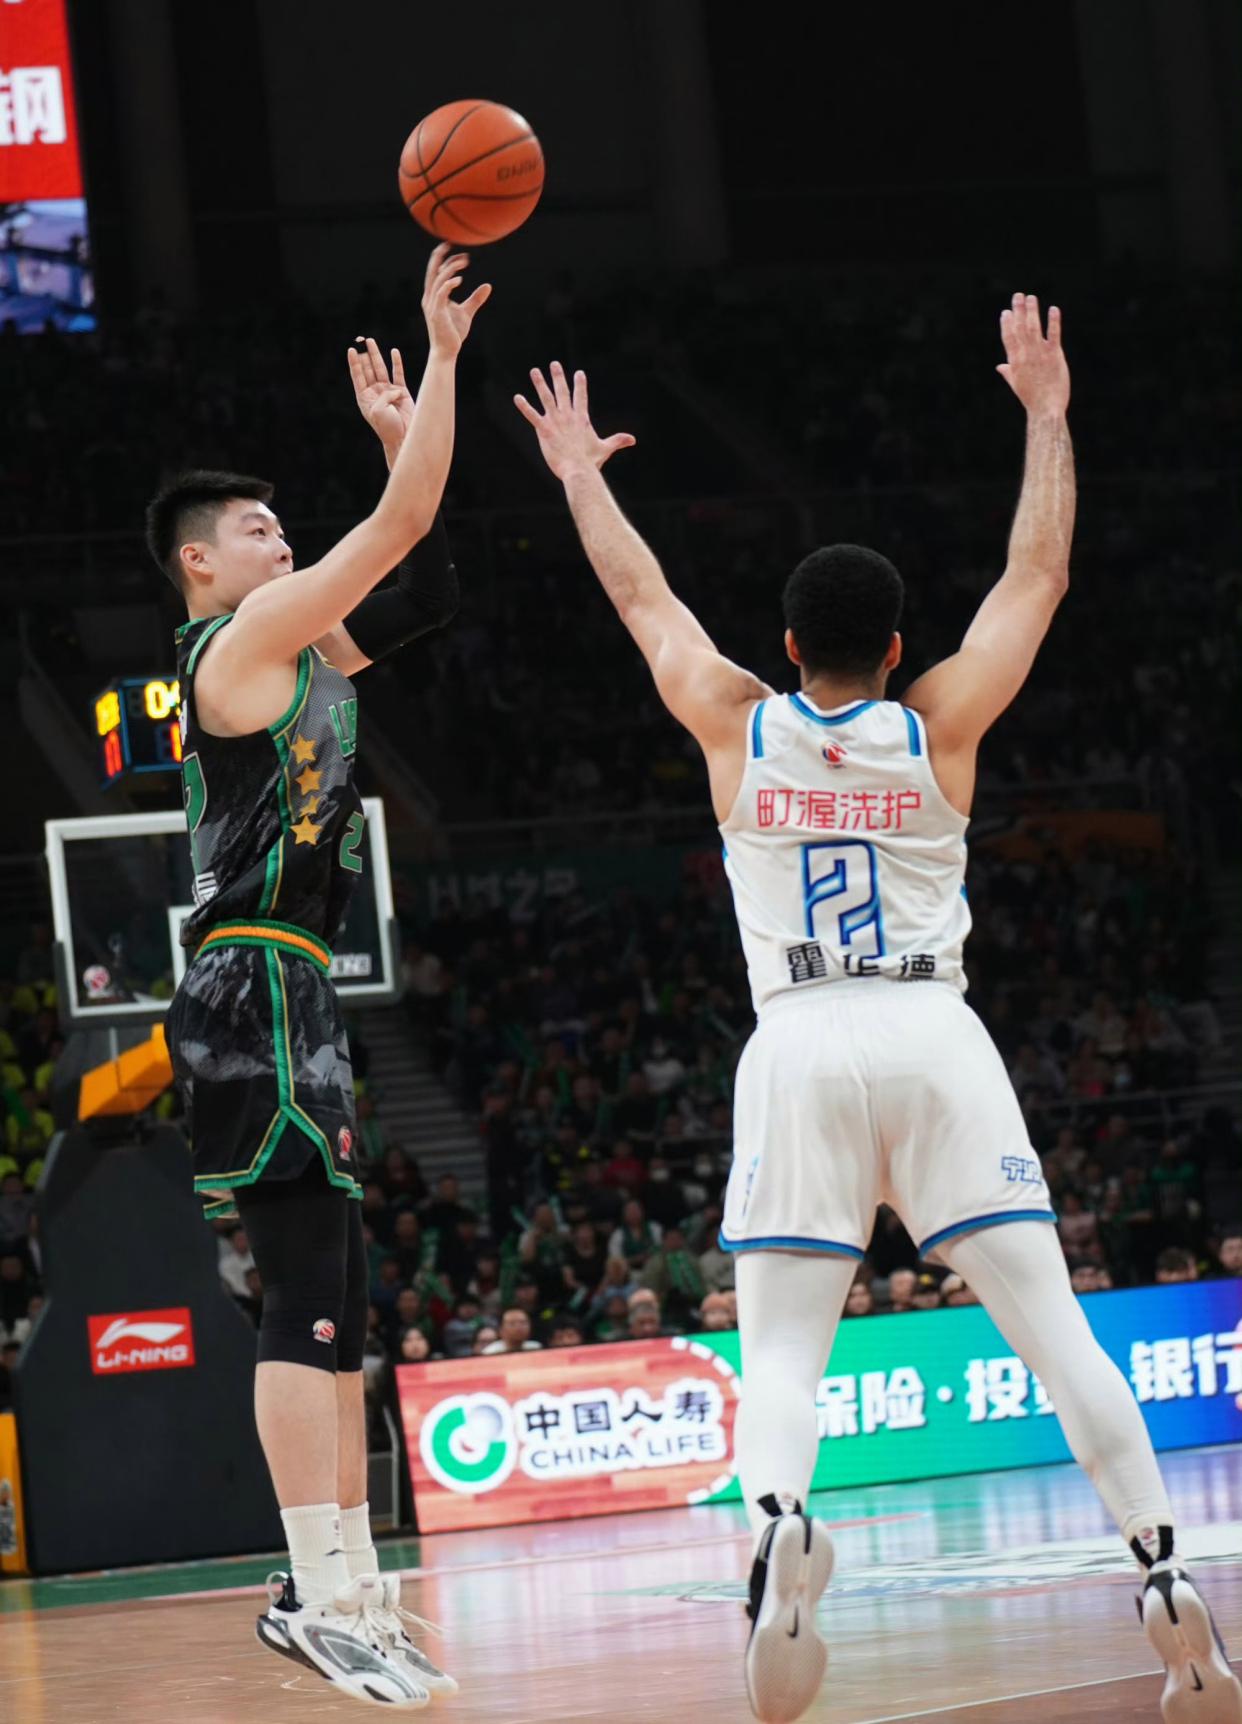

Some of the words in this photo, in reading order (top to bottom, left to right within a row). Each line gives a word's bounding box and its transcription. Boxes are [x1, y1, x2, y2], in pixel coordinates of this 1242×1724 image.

[756, 789, 922, 830] 町渥洗护
[801, 838, 887, 961] 2
[524, 1390, 711, 1440] 中国人寿
[530, 1442, 635, 1469] CHINA
[647, 1431, 716, 1459] LIFE
